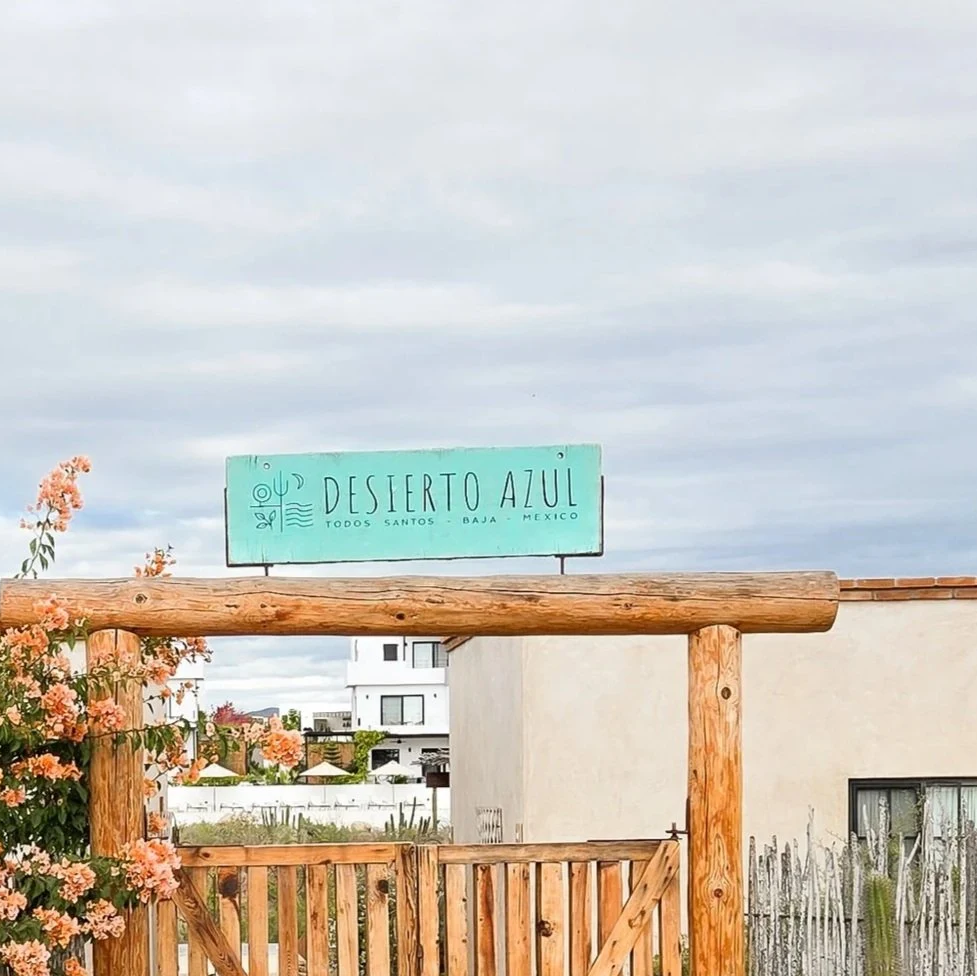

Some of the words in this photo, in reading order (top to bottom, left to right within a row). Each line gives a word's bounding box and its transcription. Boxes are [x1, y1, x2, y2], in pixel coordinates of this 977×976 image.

[324, 472, 479, 515] DESIERTO
[500, 468, 577, 508] AZUL
[326, 520, 371, 528] TODOS
[384, 517, 434, 526] SANTOS
[463, 516, 496, 524] BAJA
